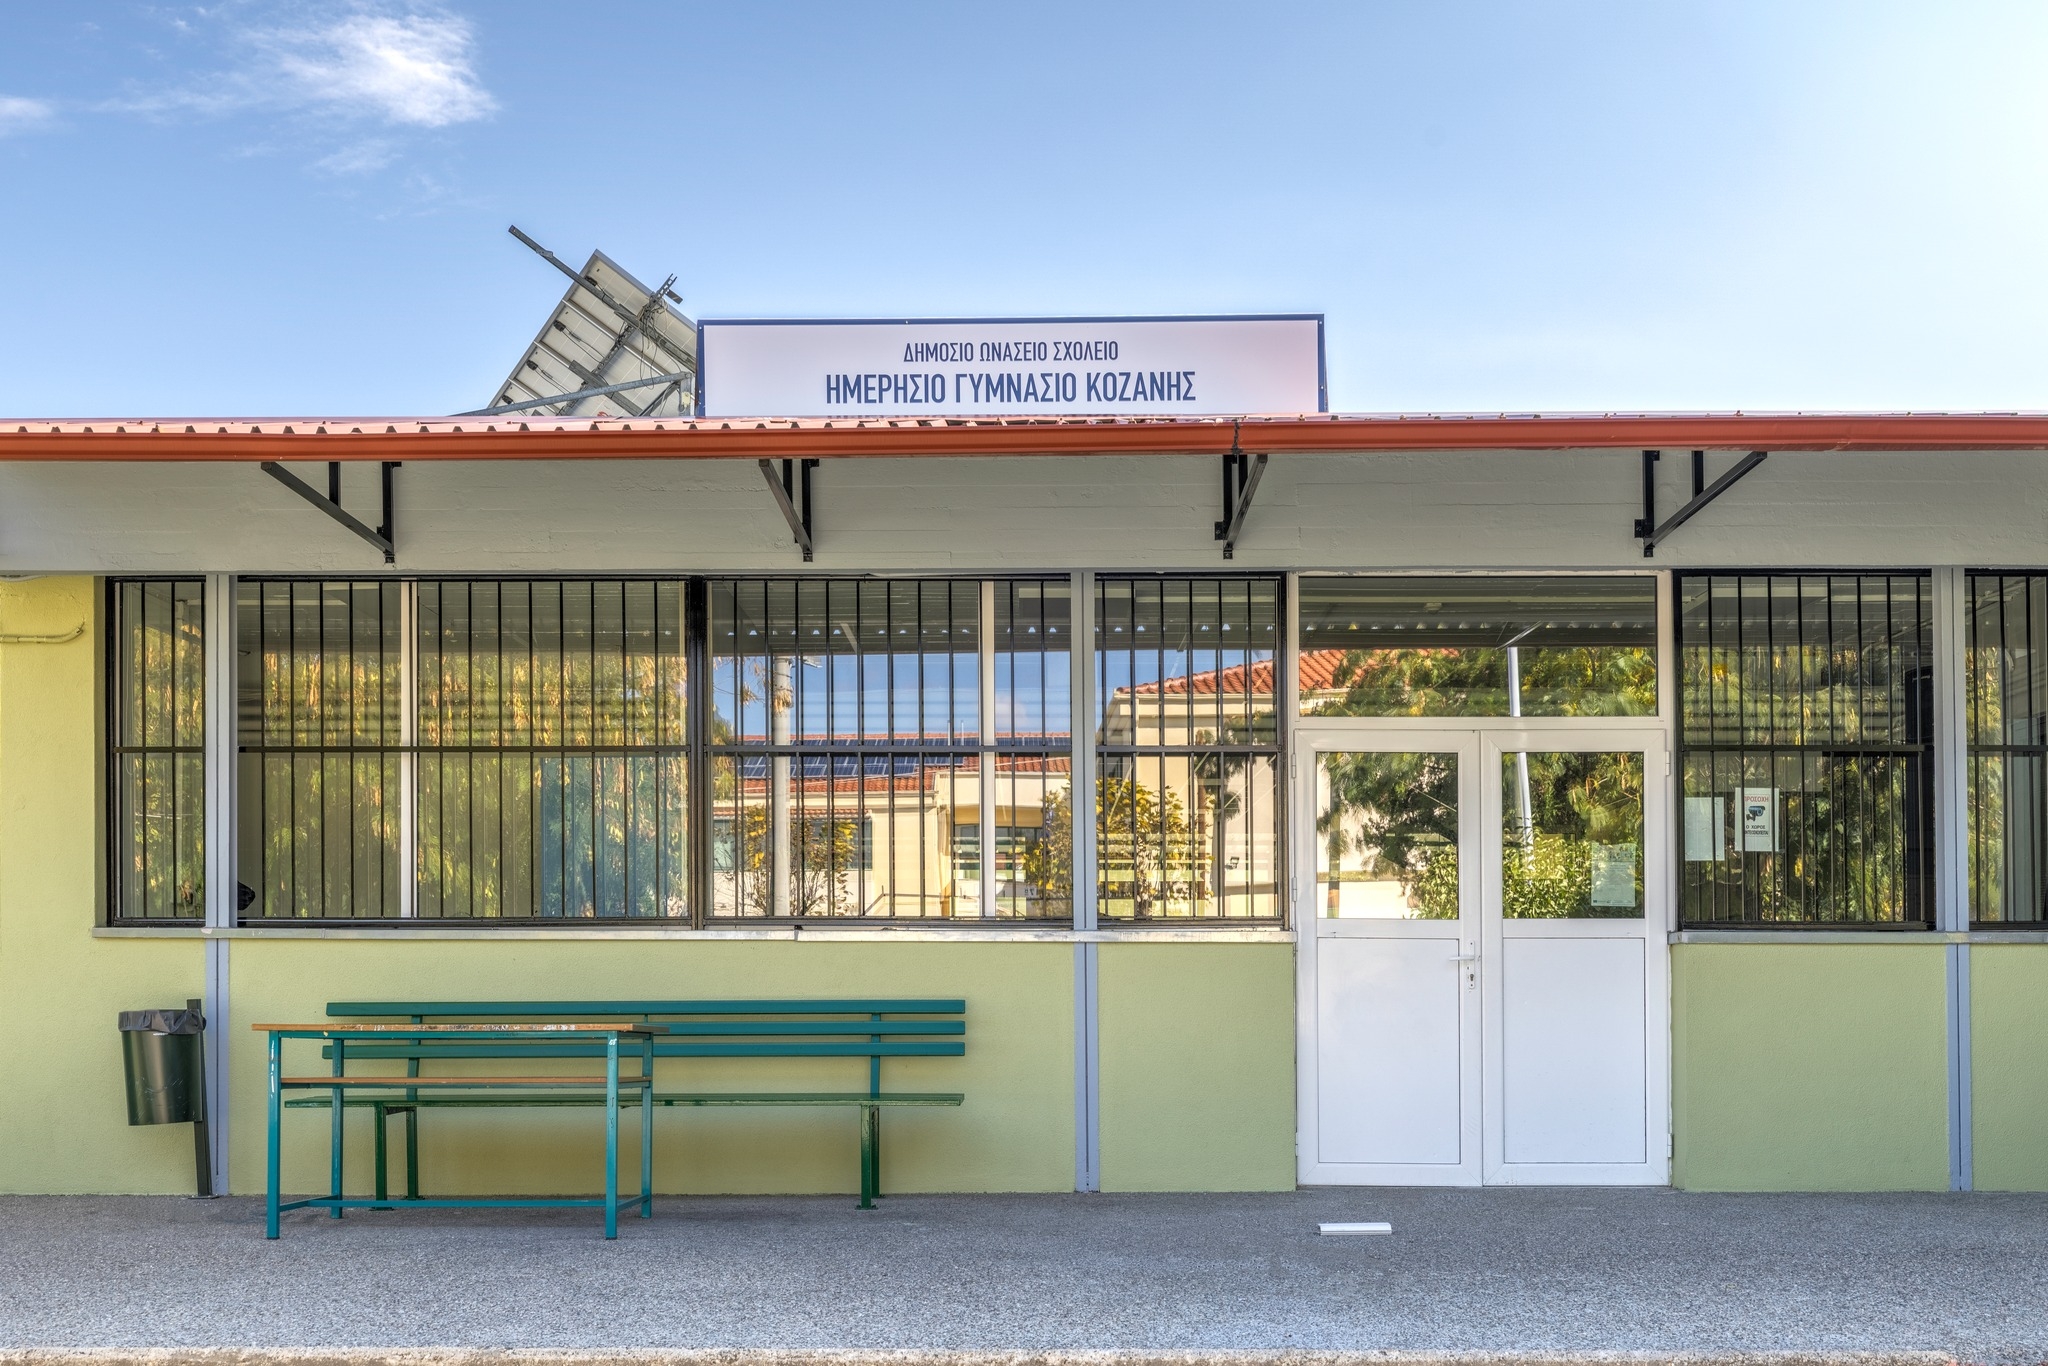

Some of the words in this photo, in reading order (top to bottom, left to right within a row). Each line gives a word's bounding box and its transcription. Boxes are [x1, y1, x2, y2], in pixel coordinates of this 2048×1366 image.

[903, 342, 974, 363] ΔΗΜΟΣΙΟ
[979, 341, 1048, 362] ΩΝΑΣΕΙΟ
[1053, 340, 1119, 361] ΣΧΟΛΕΙΟ
[826, 373, 946, 404] ΗΜΕΡΗΣΙΟ
[955, 372, 1077, 403] ΓΥΜΝΑΣΙΟ
[1086, 371, 1196, 402] ΚΟΖΑΝΗΣ
